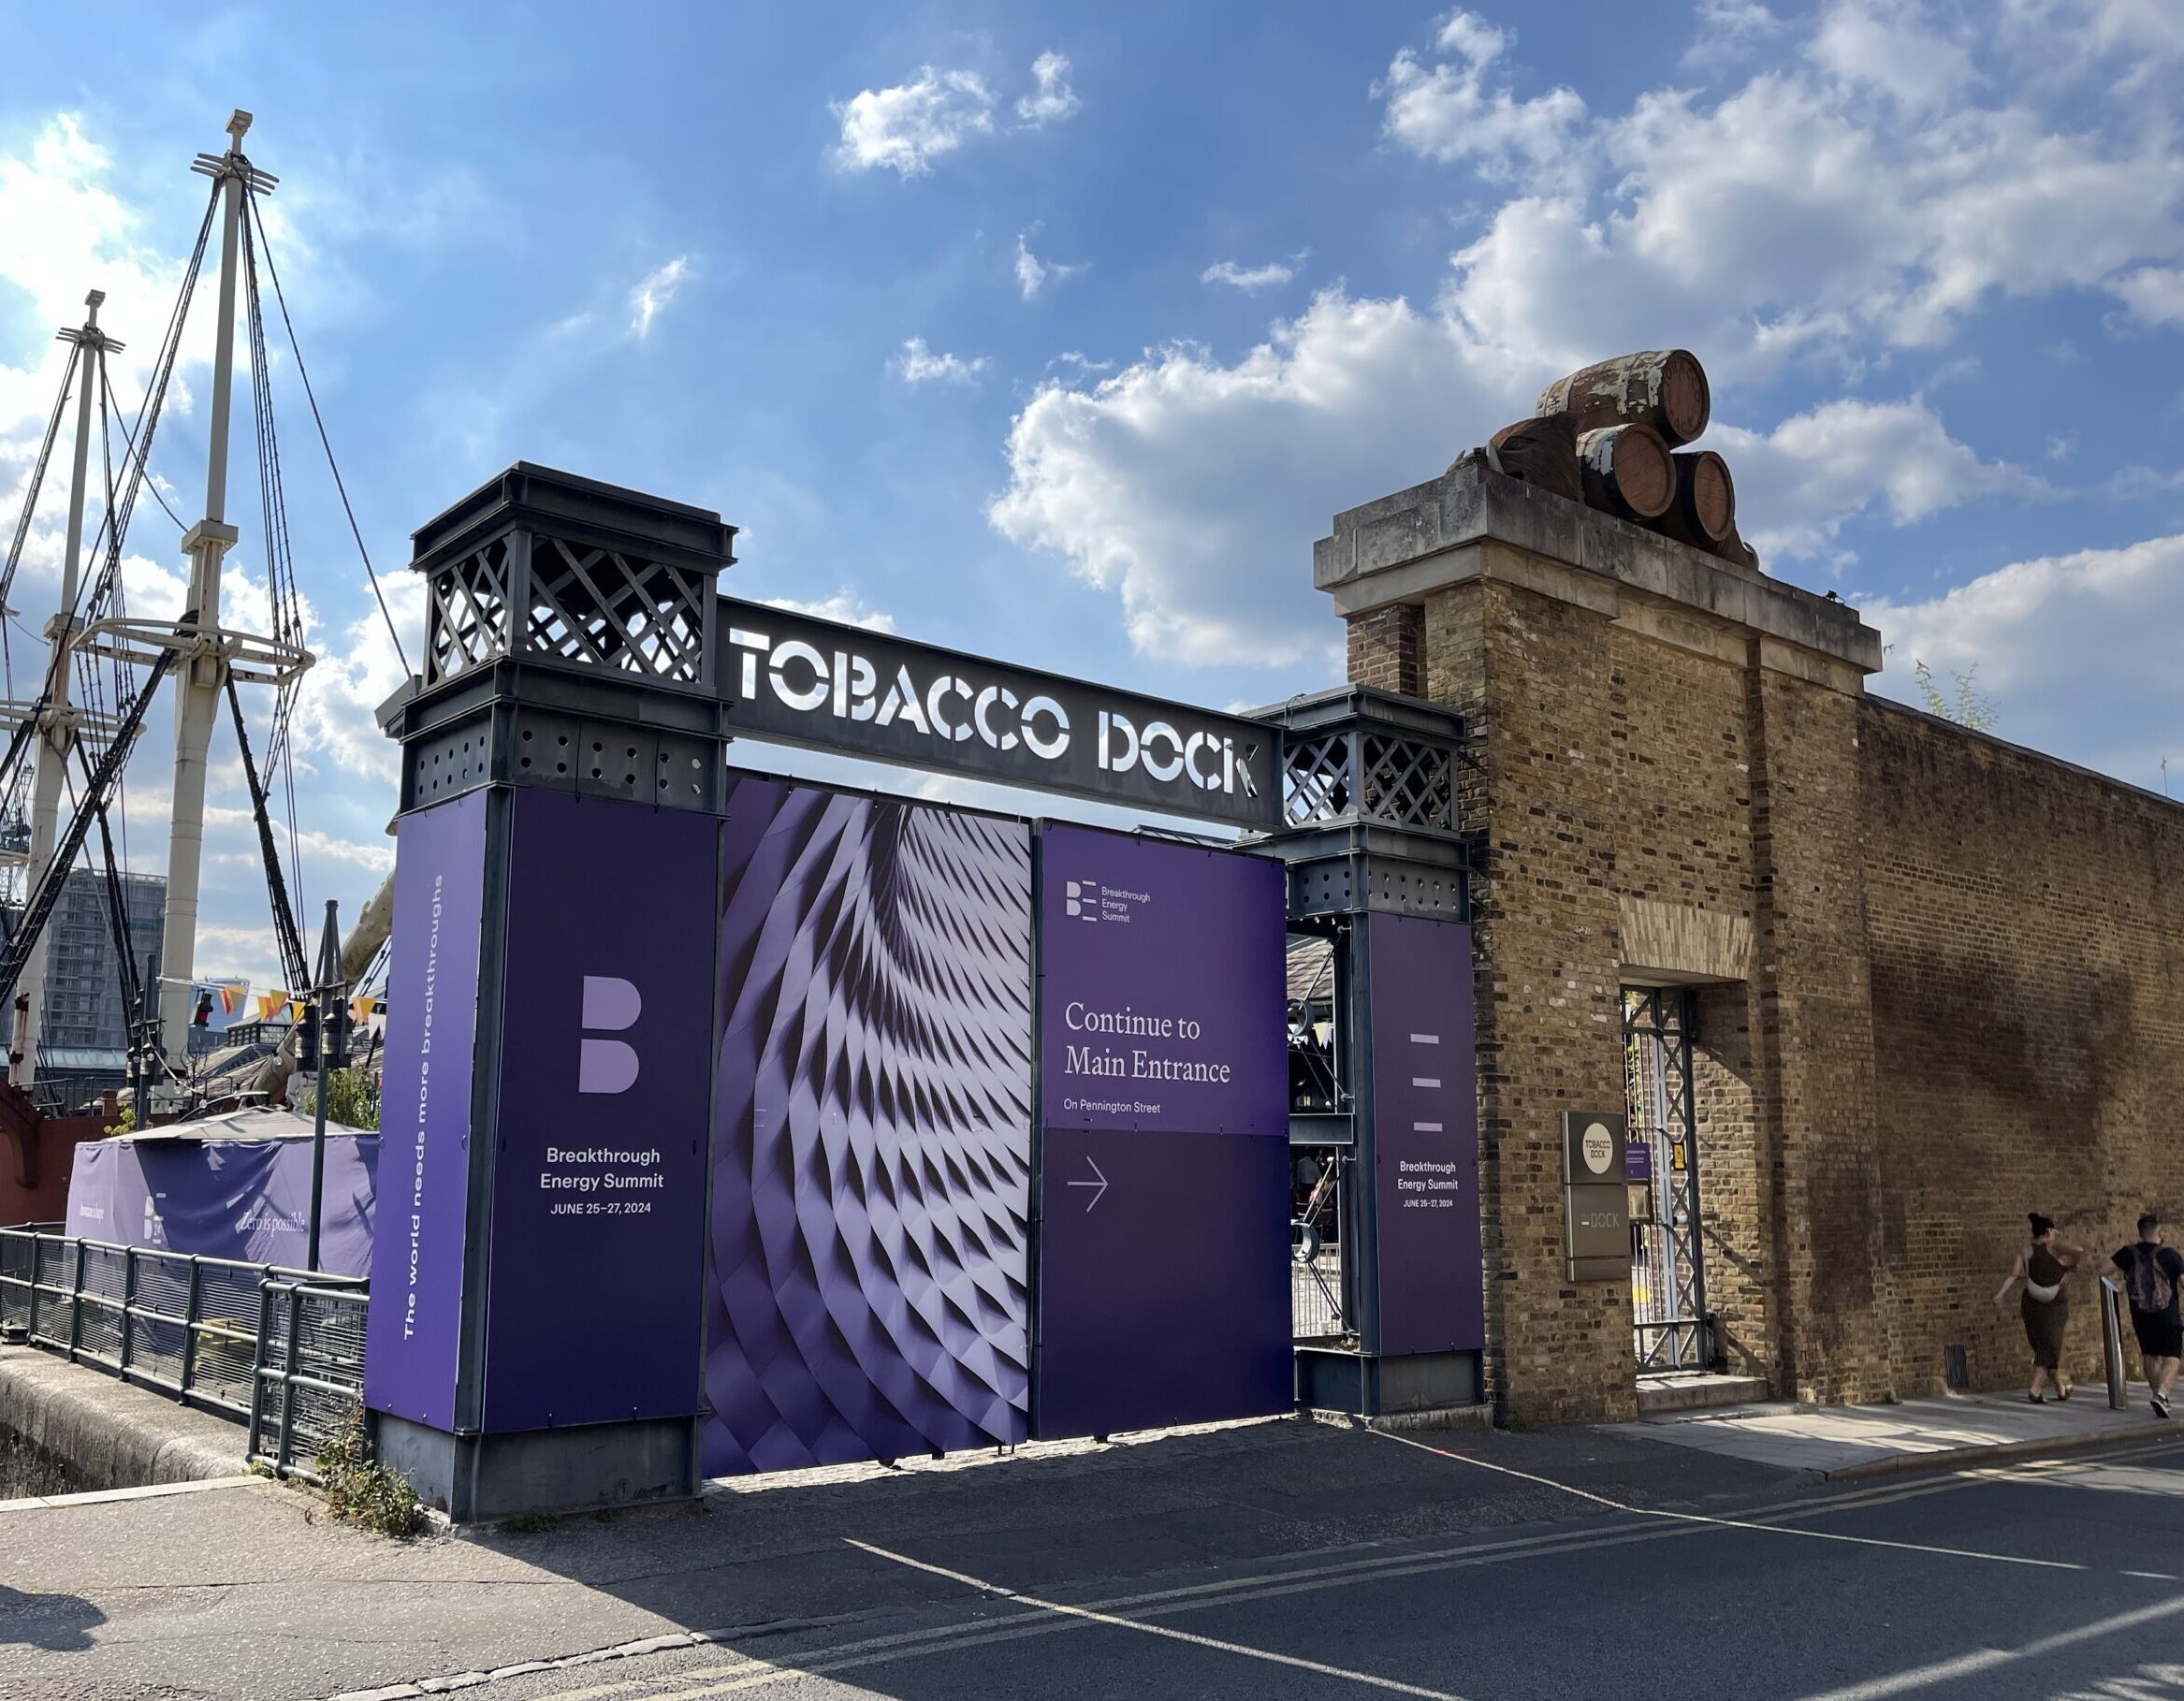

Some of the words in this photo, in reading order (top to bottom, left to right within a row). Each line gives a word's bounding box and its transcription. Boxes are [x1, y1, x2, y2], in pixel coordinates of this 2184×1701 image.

[729, 628, 1070, 760] TOBACCO
[1098, 710, 1259, 798] DOCK
[1101, 885, 1151, 904] Breakthrough
[1101, 898, 1128, 912] Energy
[1101, 910, 1130, 923] Summit
[421, 875, 443, 1054] breakthroughs
[1065, 1001, 1172, 1038] Continue
[1177, 1017, 1201, 1040] to
[1064, 1045, 1127, 1077] Main
[1130, 1050, 1230, 1083] Entrance
[418, 1061, 430, 1124] more
[1063, 1098, 1078, 1110] On
[1080, 1098, 1132, 1114] Pennington
[1133, 1101, 1161, 1113] Street
[1585, 1140, 1610, 1149] TOBACCO
[1591, 1150, 1606, 1158] DOCK
[546, 1147, 661, 1167] Breakthrough
[414, 1130, 426, 1207] needs
[1400, 1160, 1456, 1175] Breakthrough
[540, 1172, 601, 1192] Energy
[604, 1172, 664, 1189] Summit
[1397, 1178, 1427, 1192] Energy
[1427, 1178, 1459, 1191] Summit
[550, 1203, 584, 1214] JUNE
[624, 1202, 651, 1214] 2024
[1403, 1199, 1420, 1209] JUNE
[1438, 1199, 1453, 1208] 2024
[240, 1211, 263, 1230] Zero
[262, 1212, 270, 1230] is
[270, 1211, 306, 1238] possible
[1591, 1213, 1620, 1228] DOCK
[409, 1214, 420, 1287] world
[404, 1292, 416, 1341] The
